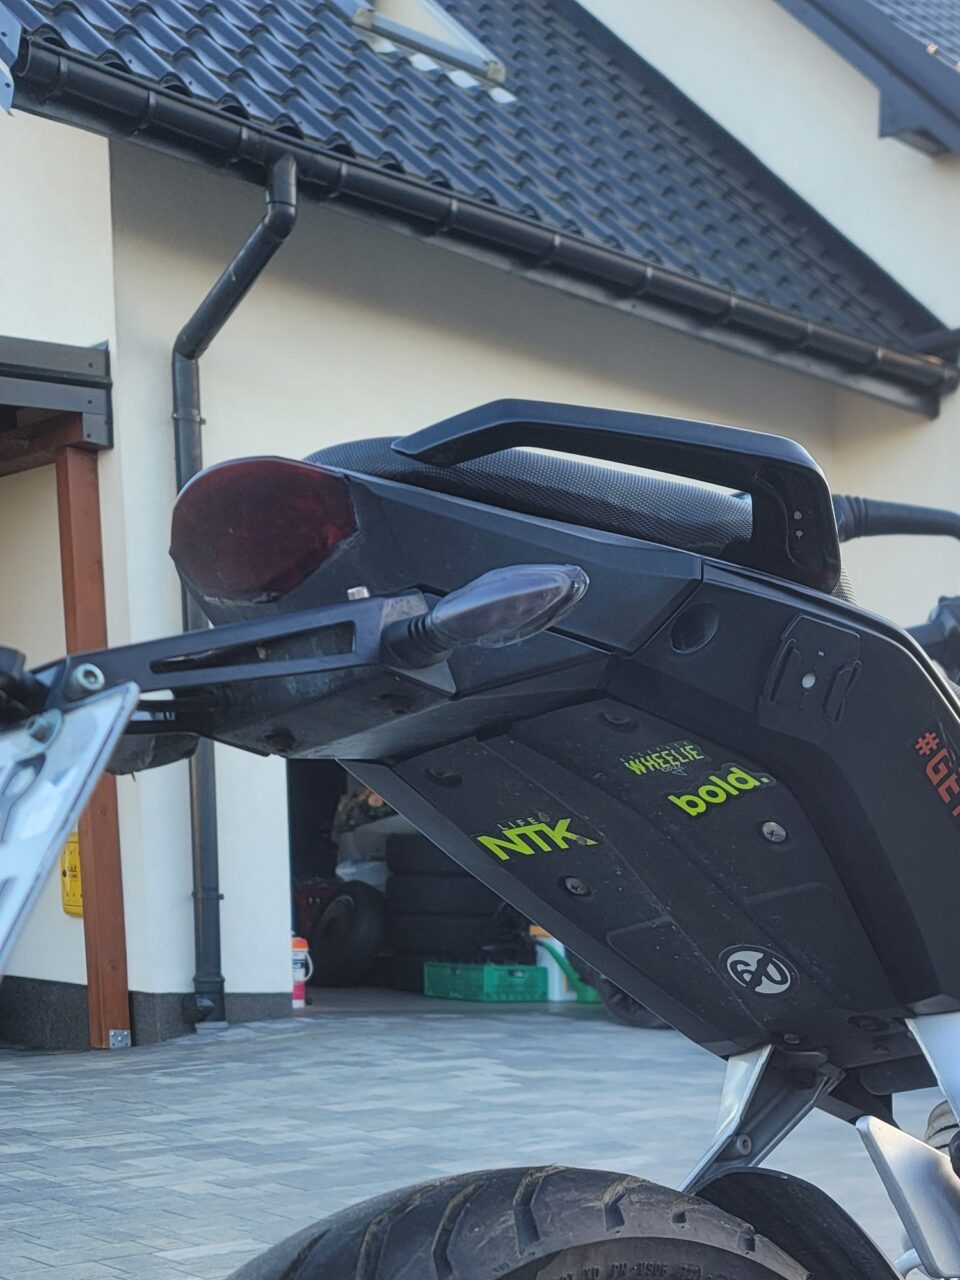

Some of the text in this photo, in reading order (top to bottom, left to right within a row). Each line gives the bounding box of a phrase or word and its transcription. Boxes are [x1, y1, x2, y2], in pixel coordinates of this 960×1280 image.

[624, 744, 705, 775] WHEELIE
[476, 818, 599, 861] NTK
[496, 817, 540, 831] LIFE
